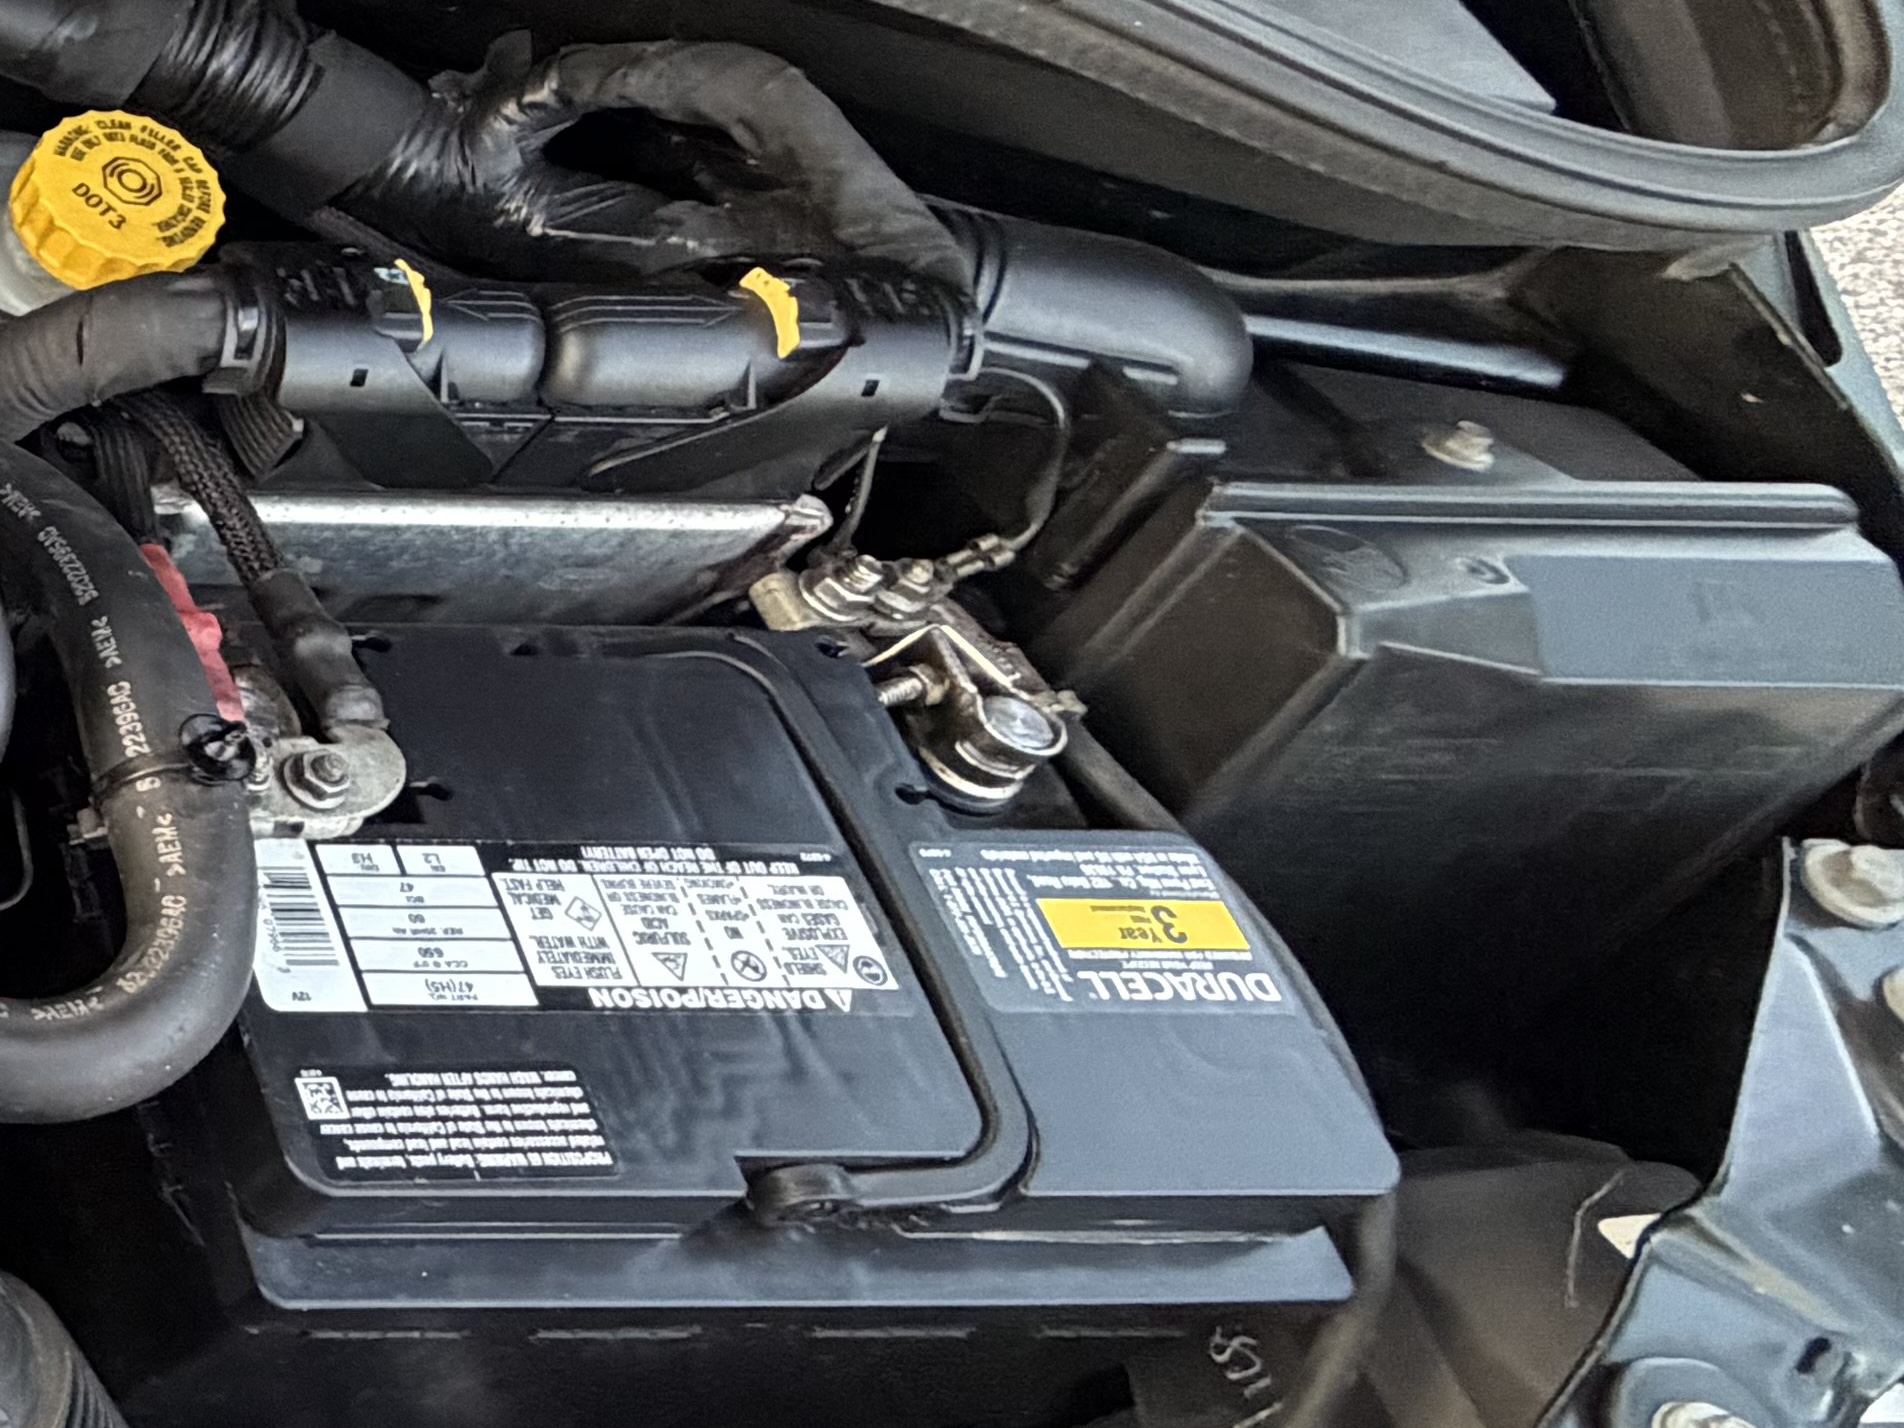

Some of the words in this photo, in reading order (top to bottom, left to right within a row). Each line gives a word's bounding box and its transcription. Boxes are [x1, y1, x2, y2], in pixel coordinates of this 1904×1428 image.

[422, 853, 441, 864] L2
[769, 861, 801, 875] KEEP
[400, 883, 414, 893] 47
[536, 879, 565, 892] HELP
[507, 892, 562, 906] MEDICAL
[531, 907, 554, 920] GET
[640, 917, 669, 930] ACID
[1151, 905, 1188, 944] 3
[632, 932, 692, 945] SULFURIC
[724, 926, 744, 940] NO
[782, 927, 849, 941] EXPLOSIVE
[1117, 927, 1162, 943] Year
[577, 936, 610, 950] WITH
[418, 947, 444, 959] 650
[536, 951, 616, 965] IMMEDIATELY
[551, 966, 583, 979] EYES
[583, 966, 622, 979] FLUSH
[783, 962, 827, 976] SHIELD
[1077, 970, 1283, 1002] DURACELL
[588, 987, 827, 1010] DANGER/POISON
